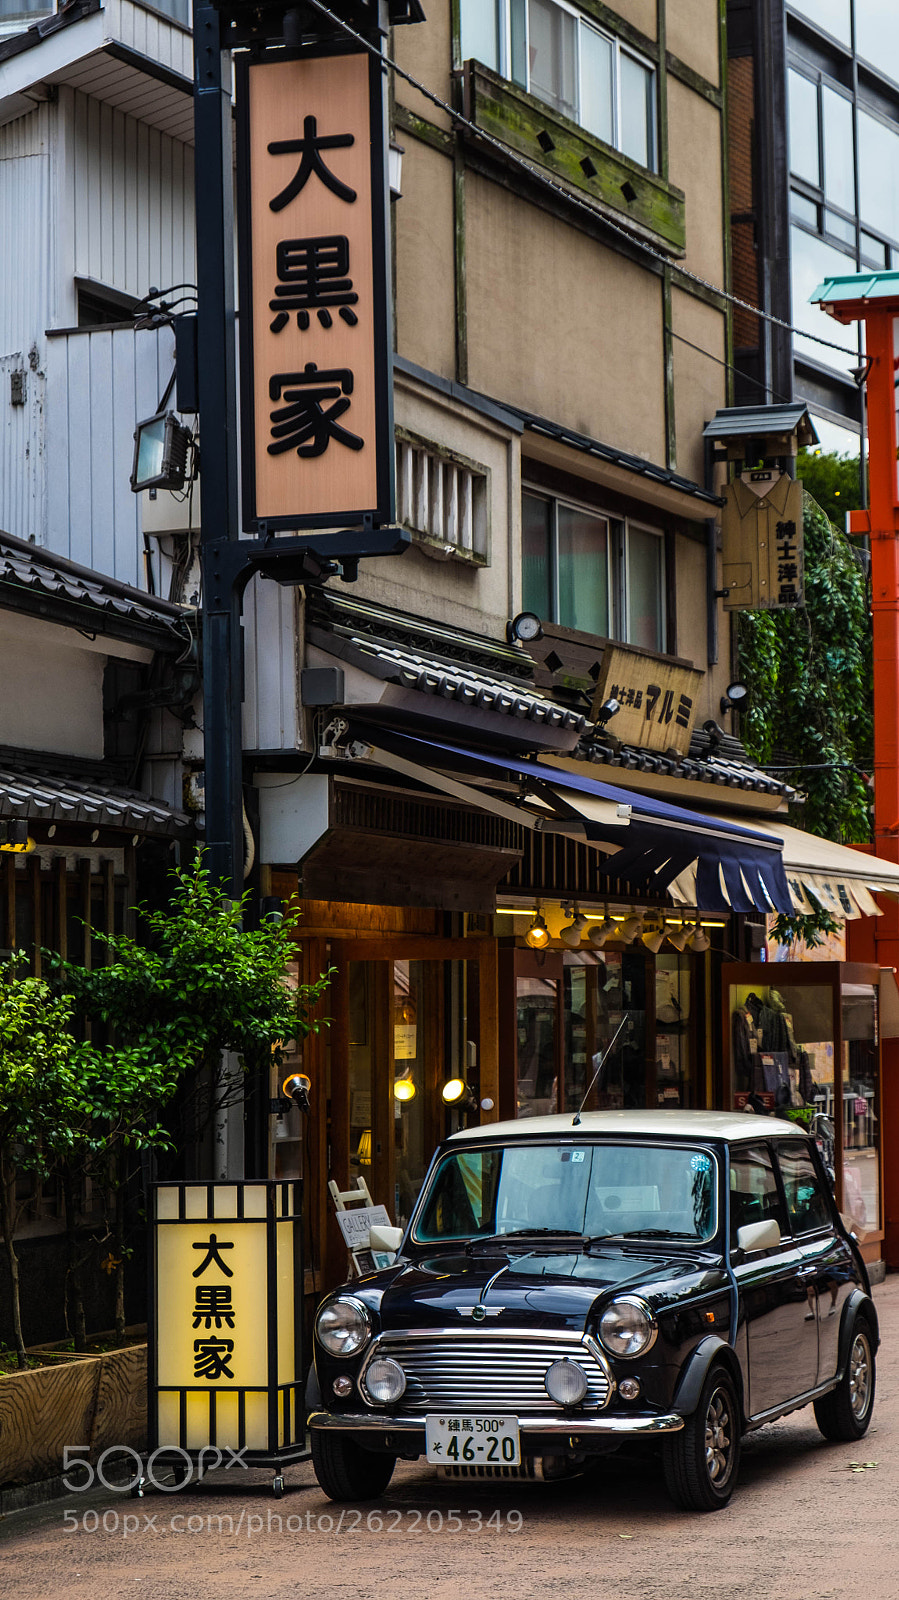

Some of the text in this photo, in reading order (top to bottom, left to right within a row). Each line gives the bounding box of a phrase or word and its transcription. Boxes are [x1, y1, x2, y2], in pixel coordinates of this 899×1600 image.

[267, 115, 364, 458] 大黒家
[775, 520, 799, 603] 紳士洋品
[645, 684, 693, 729] マルミ
[192, 1233, 236, 1380] 大黒家
[432, 1436, 515, 1461] そ 46-20
